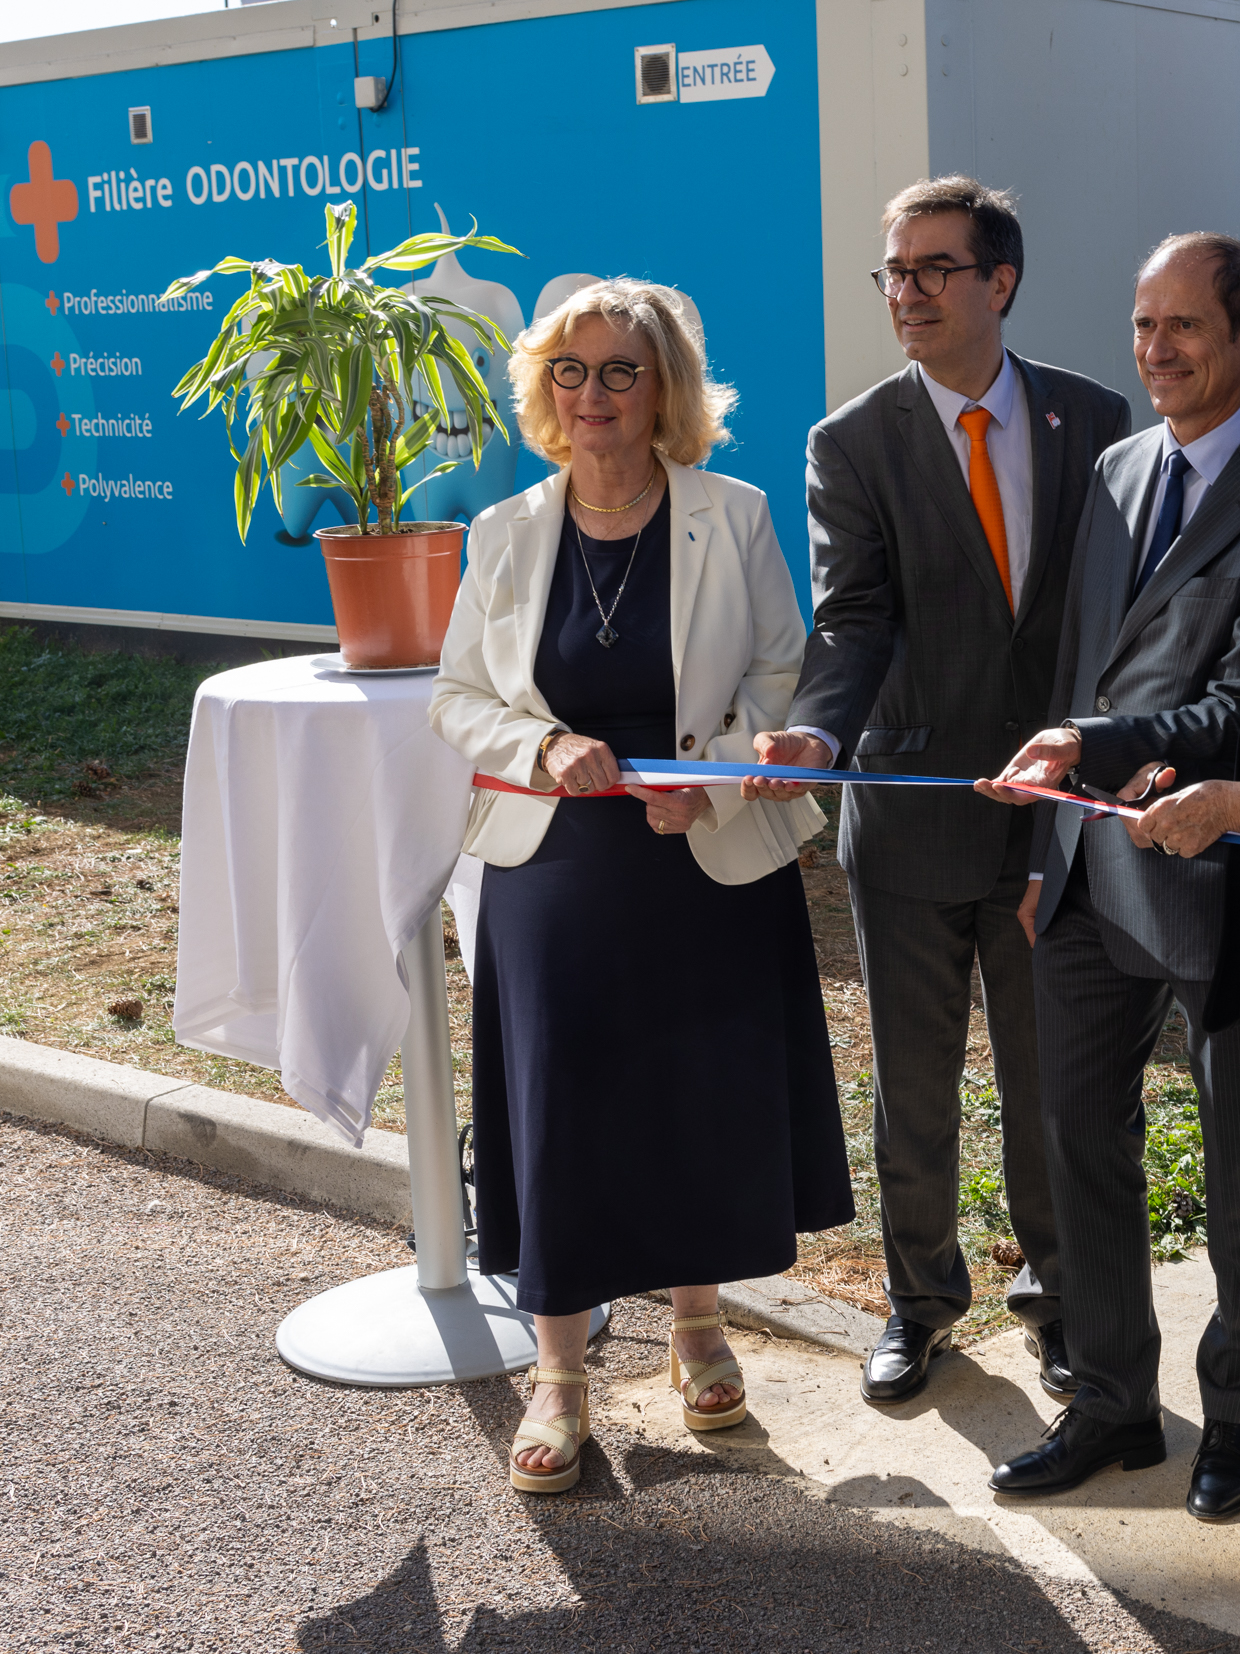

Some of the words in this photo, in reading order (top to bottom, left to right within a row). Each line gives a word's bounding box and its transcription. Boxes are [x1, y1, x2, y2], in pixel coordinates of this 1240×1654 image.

[680, 53, 757, 88] ENTRÉE
[87, 167, 173, 213] Filière
[186, 146, 423, 205] ODONTOLOGIE
[69, 351, 142, 376] Précision
[71, 412, 152, 437] Technicité
[78, 473, 173, 502] Polyvalence
